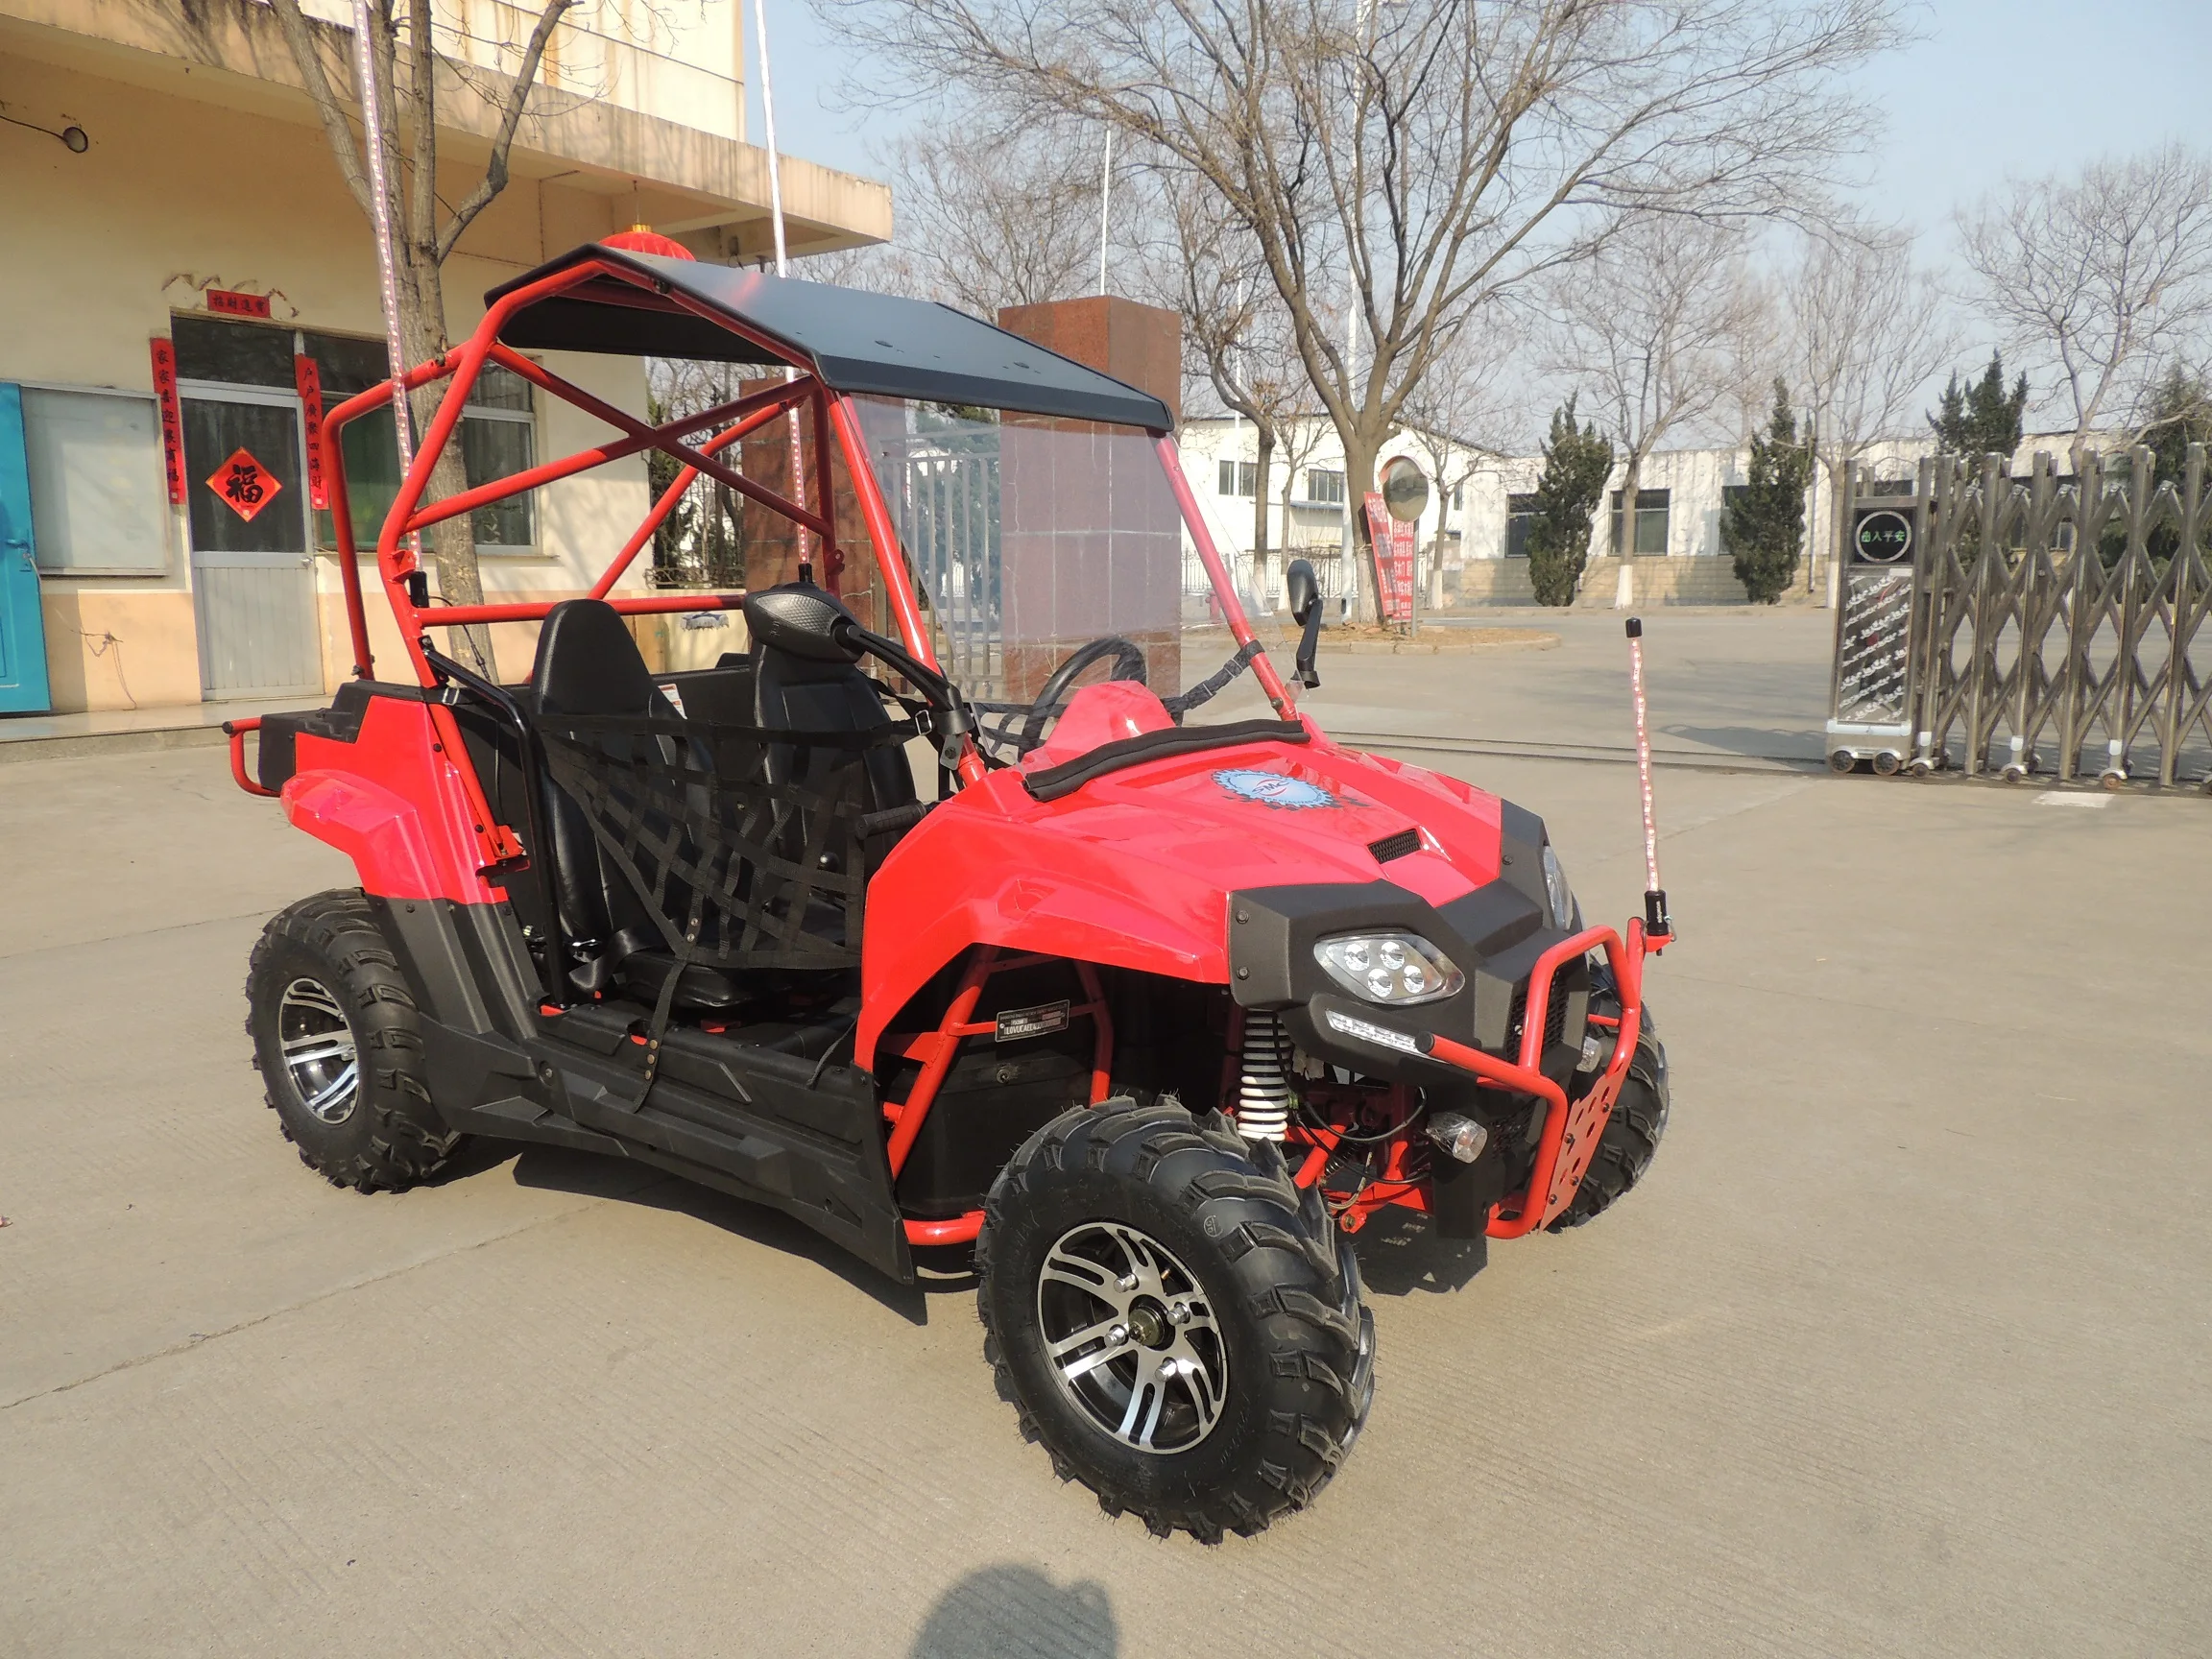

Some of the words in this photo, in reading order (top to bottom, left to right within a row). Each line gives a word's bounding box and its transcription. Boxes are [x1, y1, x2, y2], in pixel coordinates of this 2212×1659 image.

[226, 464, 264, 503] 福
[1861, 530, 1906, 543] 出入平安
[1251, 780, 1290, 794] SMC
